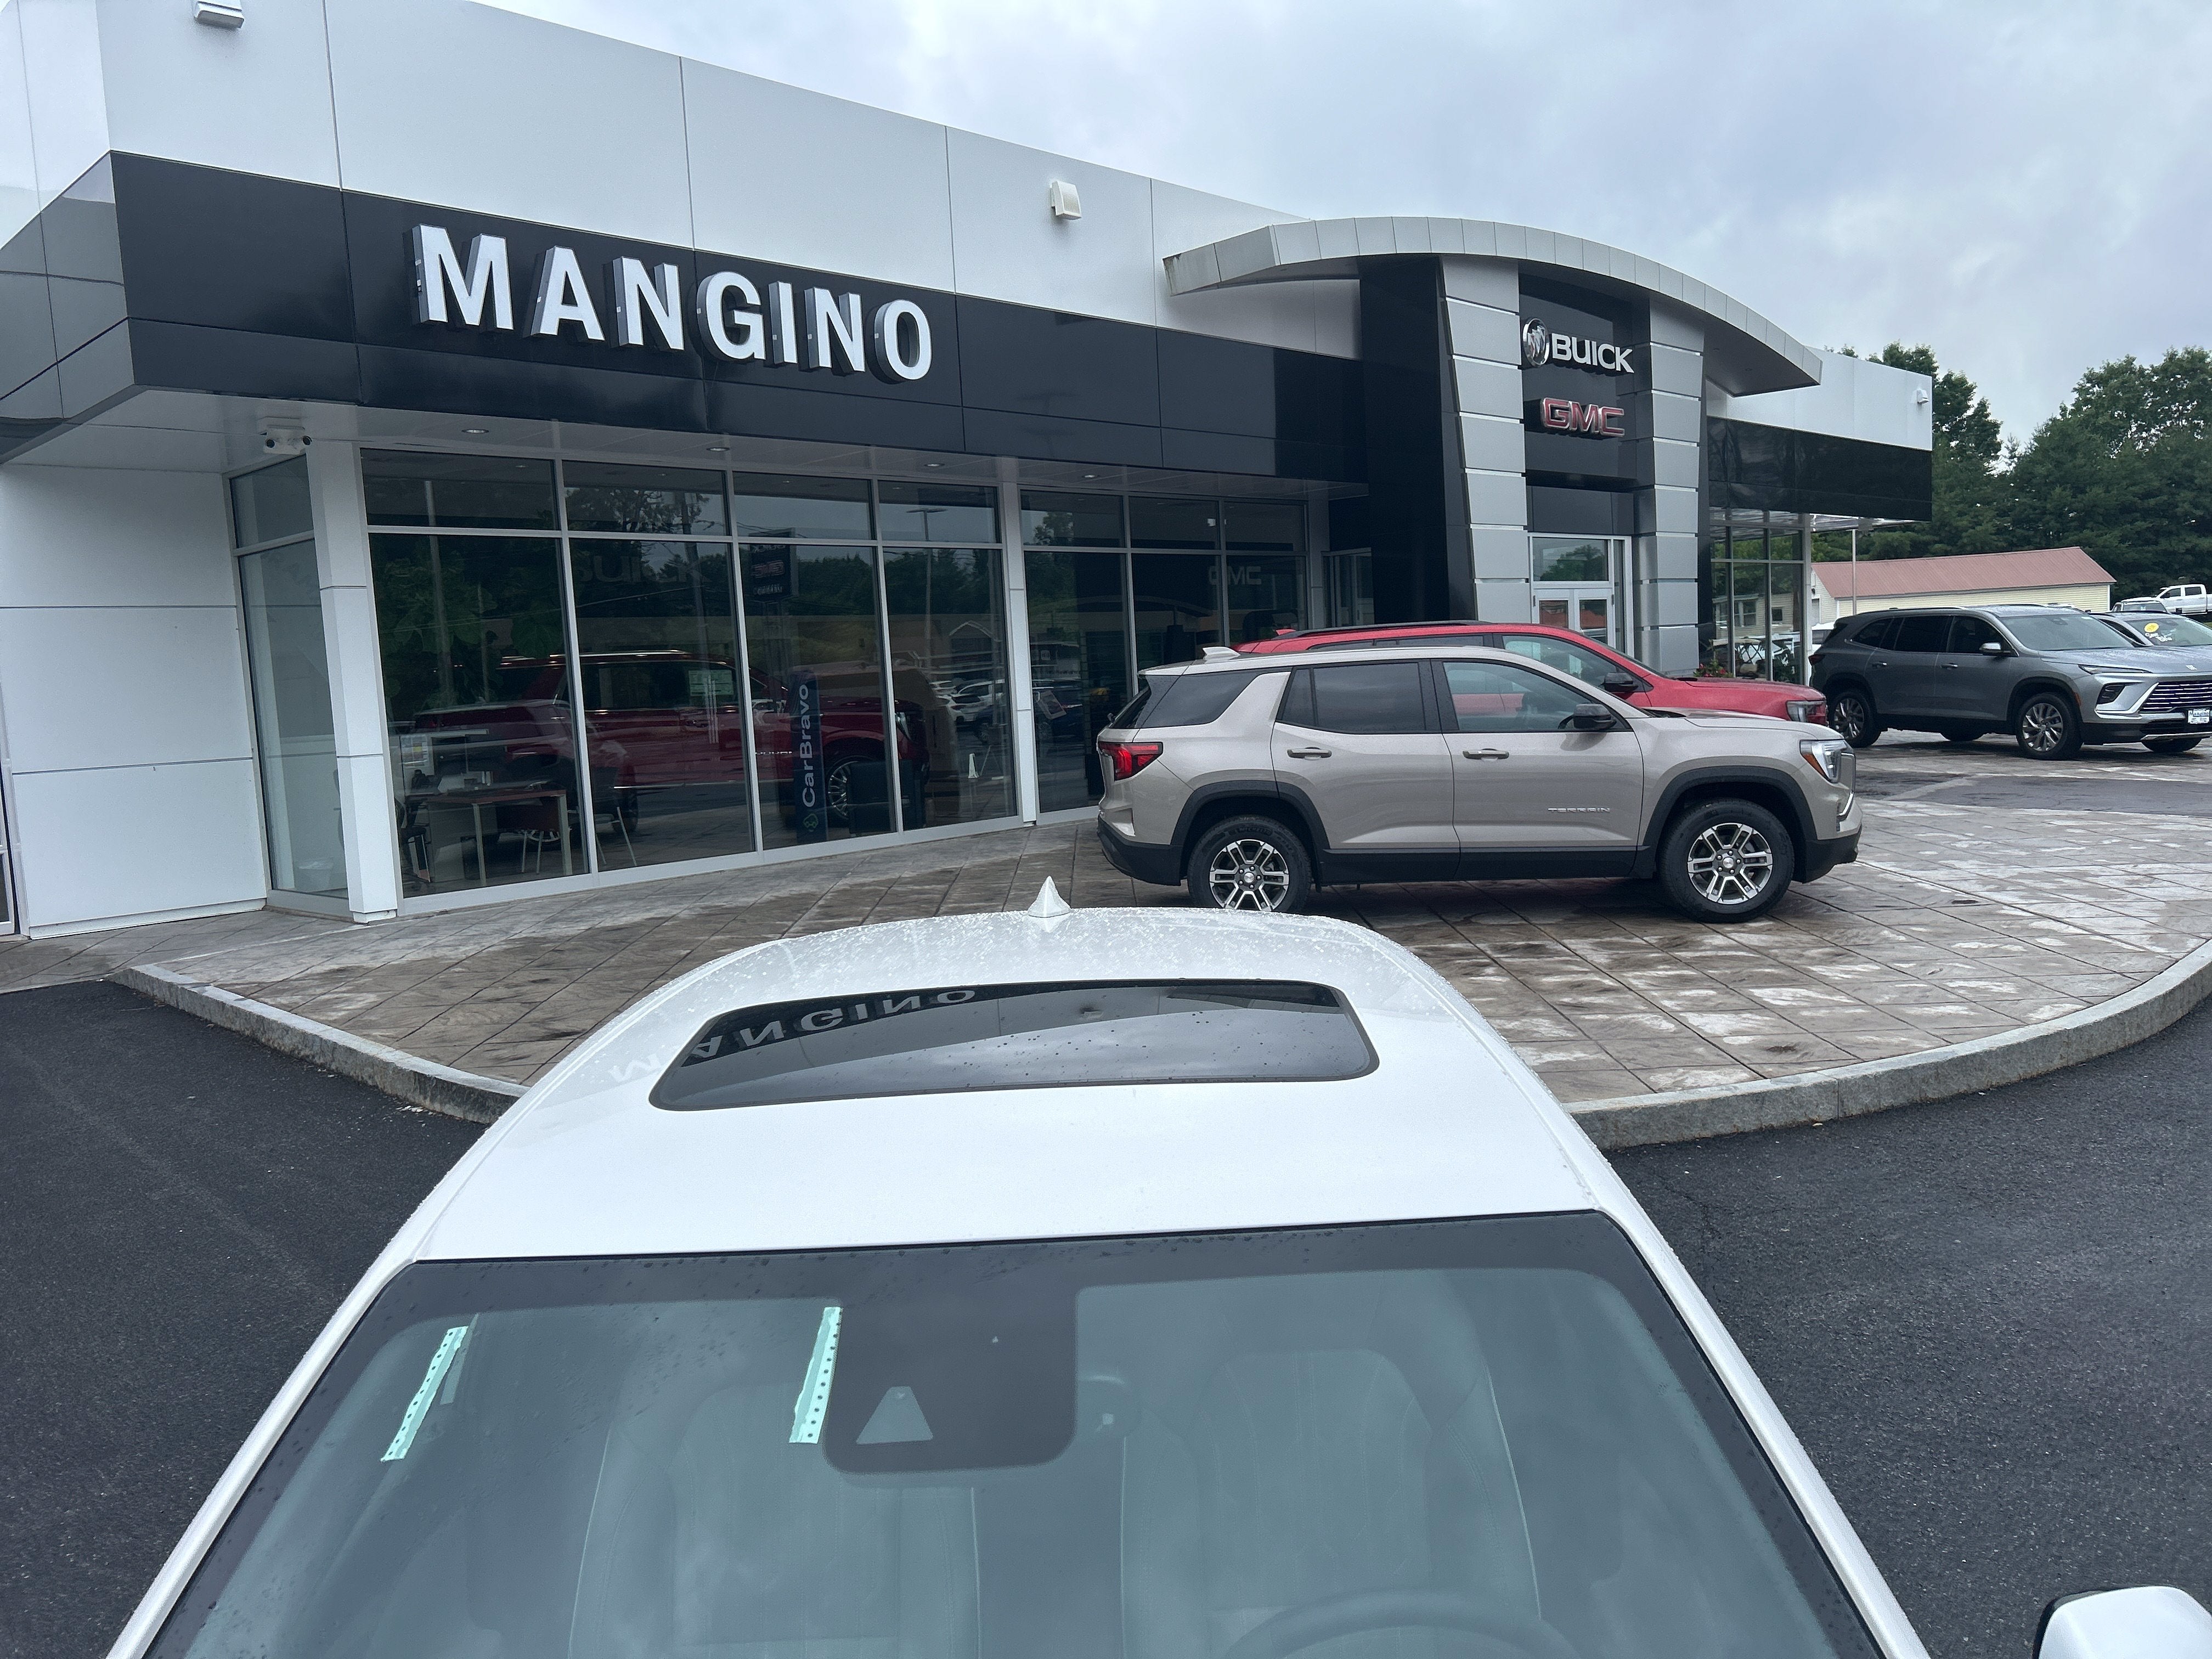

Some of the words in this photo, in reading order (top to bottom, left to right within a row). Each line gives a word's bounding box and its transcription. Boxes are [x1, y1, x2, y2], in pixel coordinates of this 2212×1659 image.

[413, 223, 932, 381] MANGINO
[1552, 333, 1634, 374] BUICK
[1542, 397, 1625, 437] GMC
[799, 684, 815, 808] CarBravo
